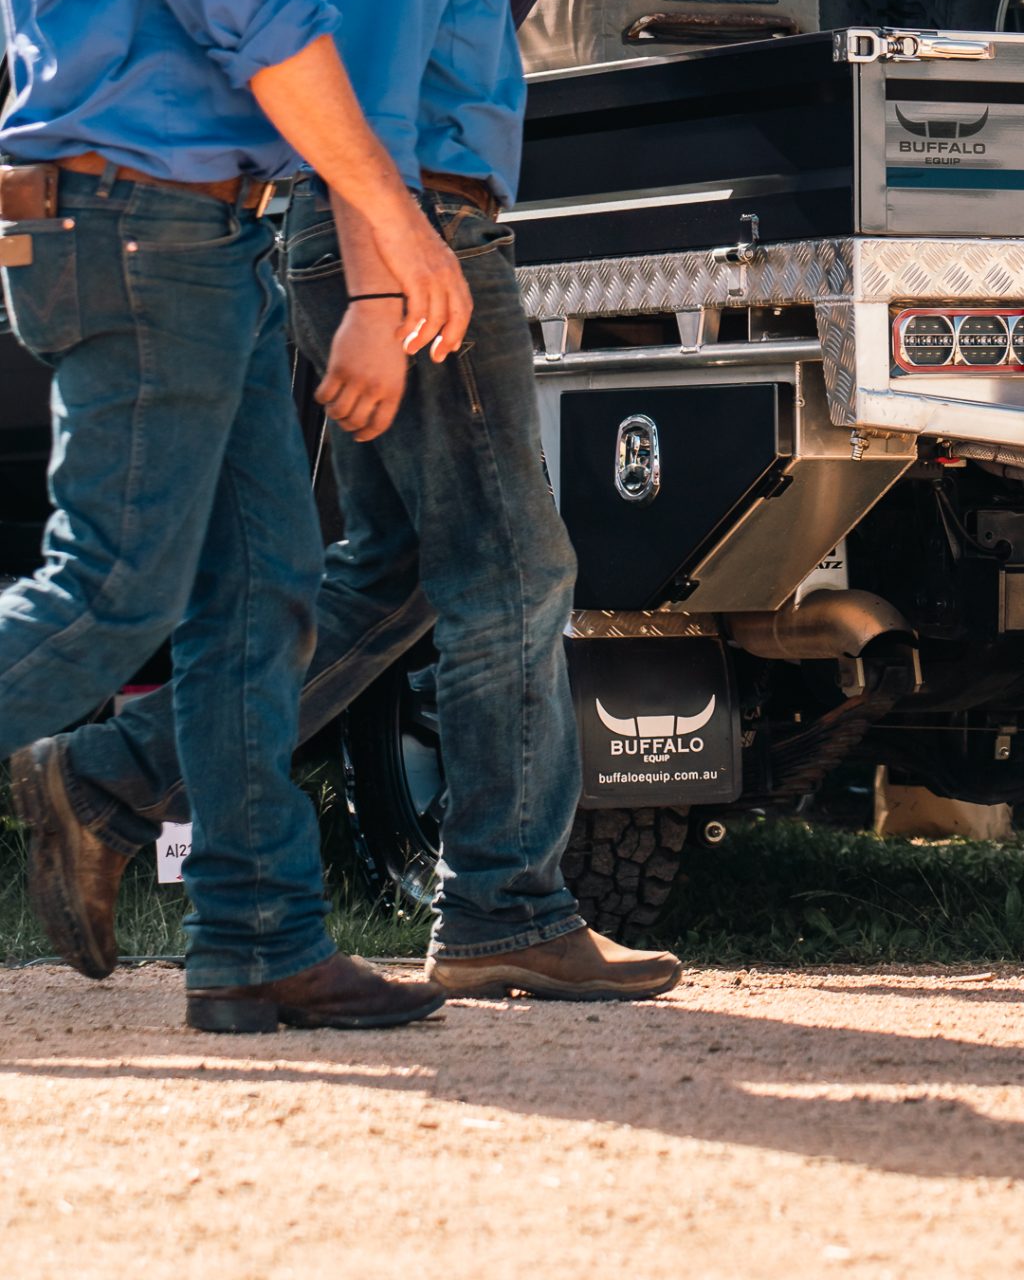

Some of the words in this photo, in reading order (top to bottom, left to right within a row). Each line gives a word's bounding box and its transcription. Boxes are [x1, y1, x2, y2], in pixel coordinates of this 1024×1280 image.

[899, 141, 986, 154] BUFFALO
[924, 157, 961, 165] EQUIP
[610, 737, 704, 755] BUFFALO
[643, 754, 670, 763] EQUIP
[598, 771, 718, 784] buffaloequip.com.au
